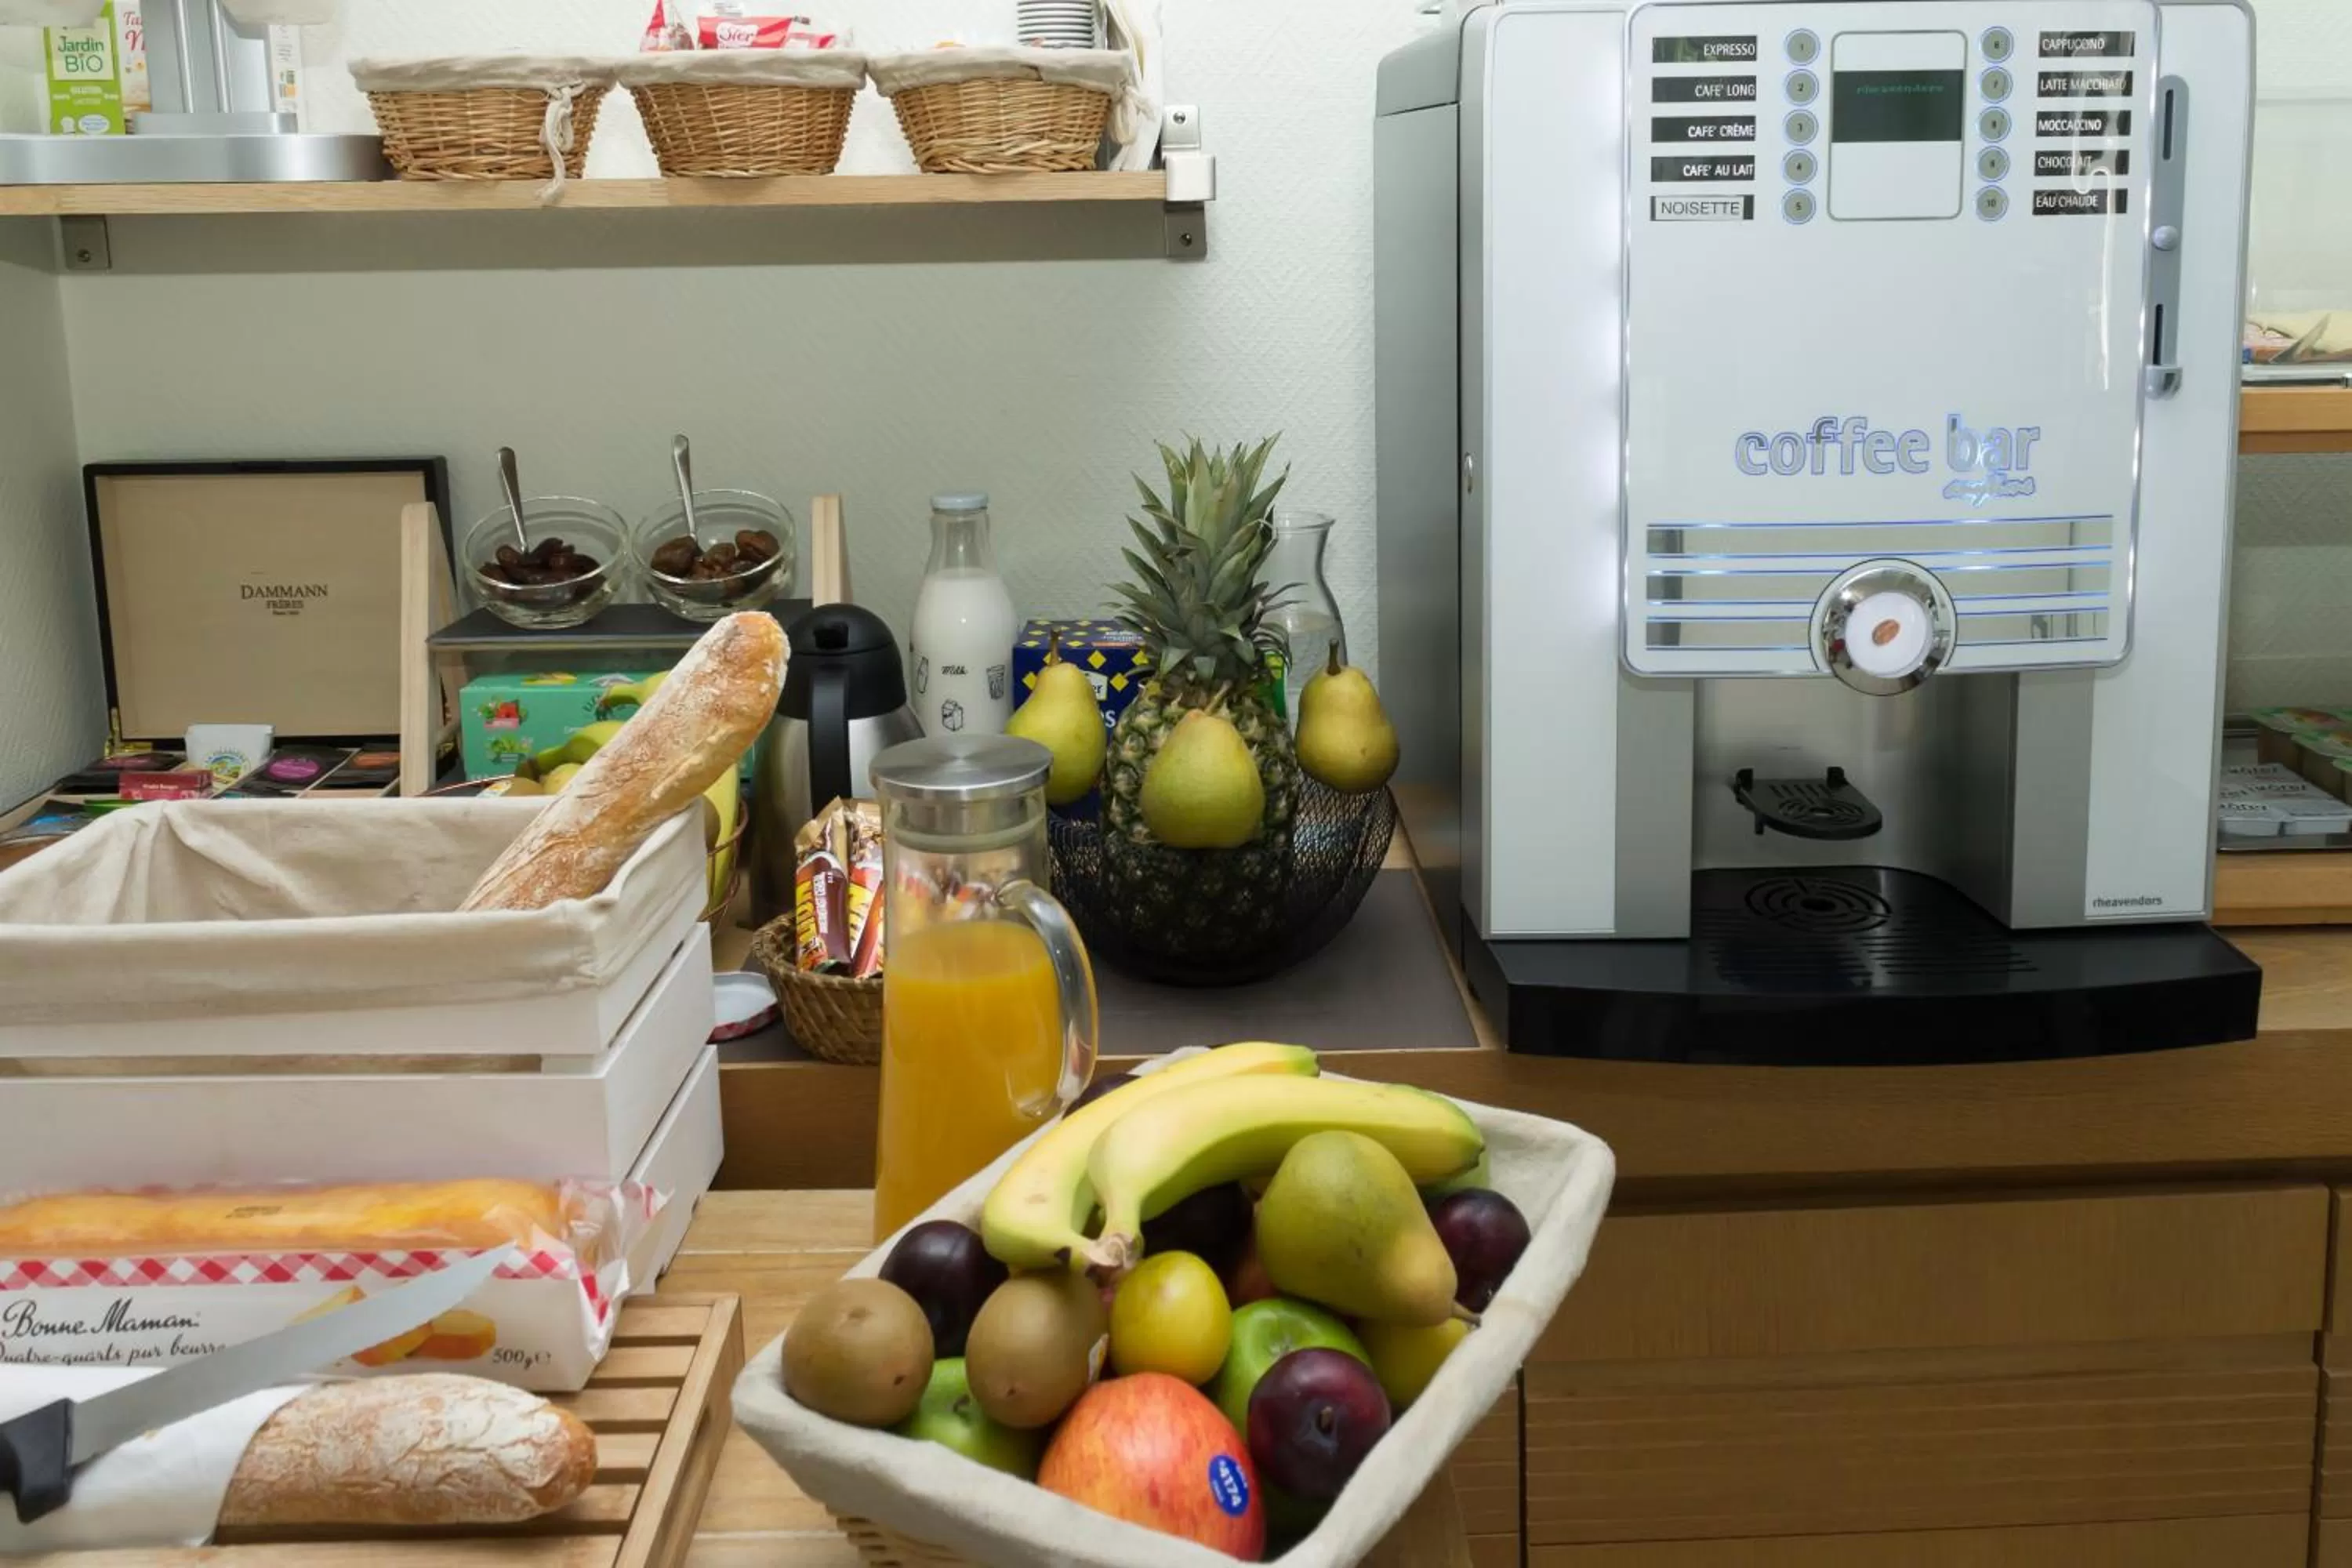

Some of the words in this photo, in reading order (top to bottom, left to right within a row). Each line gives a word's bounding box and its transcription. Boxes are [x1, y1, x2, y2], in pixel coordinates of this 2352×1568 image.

[57, 36, 104, 53] Jardin
[1703, 43, 1755, 56] EXPRESSO
[1726, 84, 1755, 96] LONG
[2040, 78, 2067, 91] LATTE
[2038, 118, 2102, 131] MOCCACCINO
[1715, 164, 1730, 176] AU
[1732, 163, 1754, 176] LAIT
[1987, 198, 1997, 208] 10
[2036, 196, 2056, 208] EAU
[2058, 195, 2099, 208] CHAUDE
[1661, 201, 1740, 216] NOISETTE
[1734, 416, 1930, 476] coffee
[1946, 412, 2041, 473] bar
[241, 583, 328, 600] DAMMANN
[2, 1299, 88, 1339] Bonne
[89, 1297, 200, 1334] Maman
[128, 1345, 163, 1367] pur
